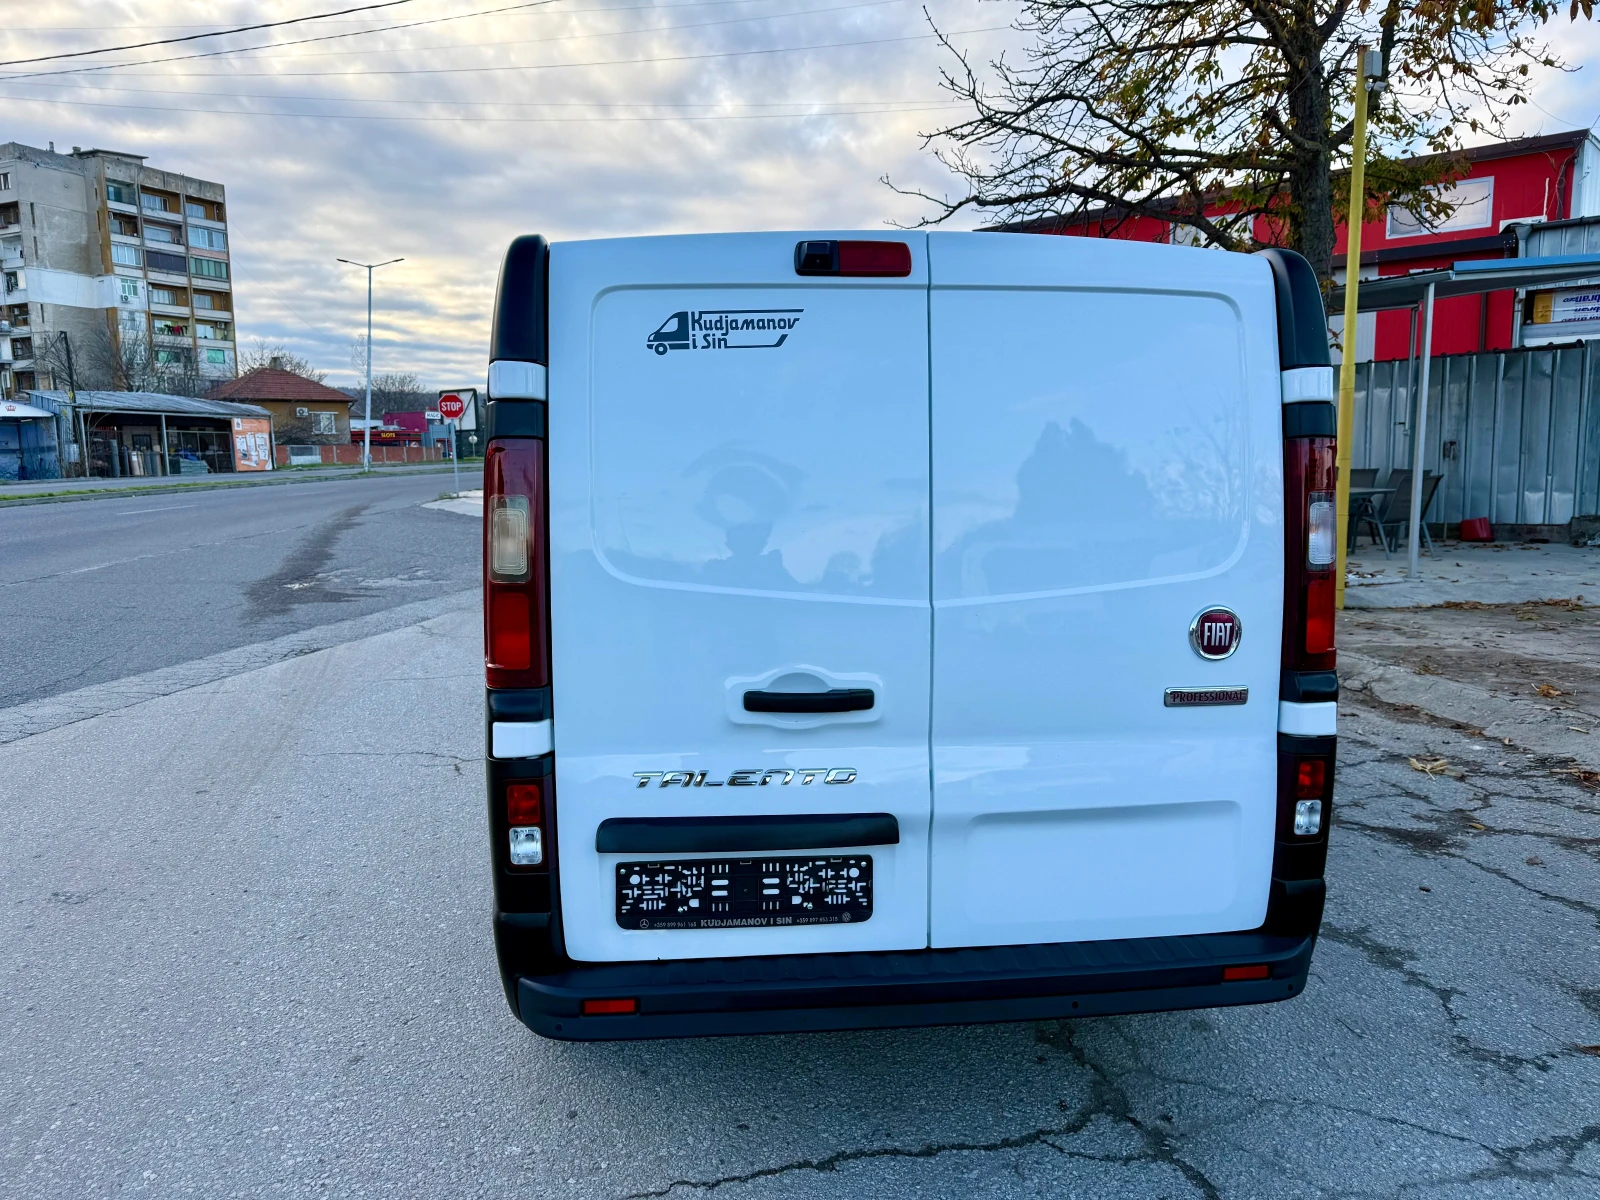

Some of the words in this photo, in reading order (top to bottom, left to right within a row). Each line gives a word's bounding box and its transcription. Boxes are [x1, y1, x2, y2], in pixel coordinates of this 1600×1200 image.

[691, 311, 800, 336] Kudjamanov
[701, 333, 728, 350] Sin
[441, 401, 461, 411] STOP
[1203, 622, 1233, 647] FIAT
[1172, 691, 1244, 703] PROFESSIONAL
[633, 767, 858, 788] TALENTO
[701, 917, 768, 927] KUDJAMANOV
[770, 917, 774, 925] I
[776, 916, 792, 925] SIN
